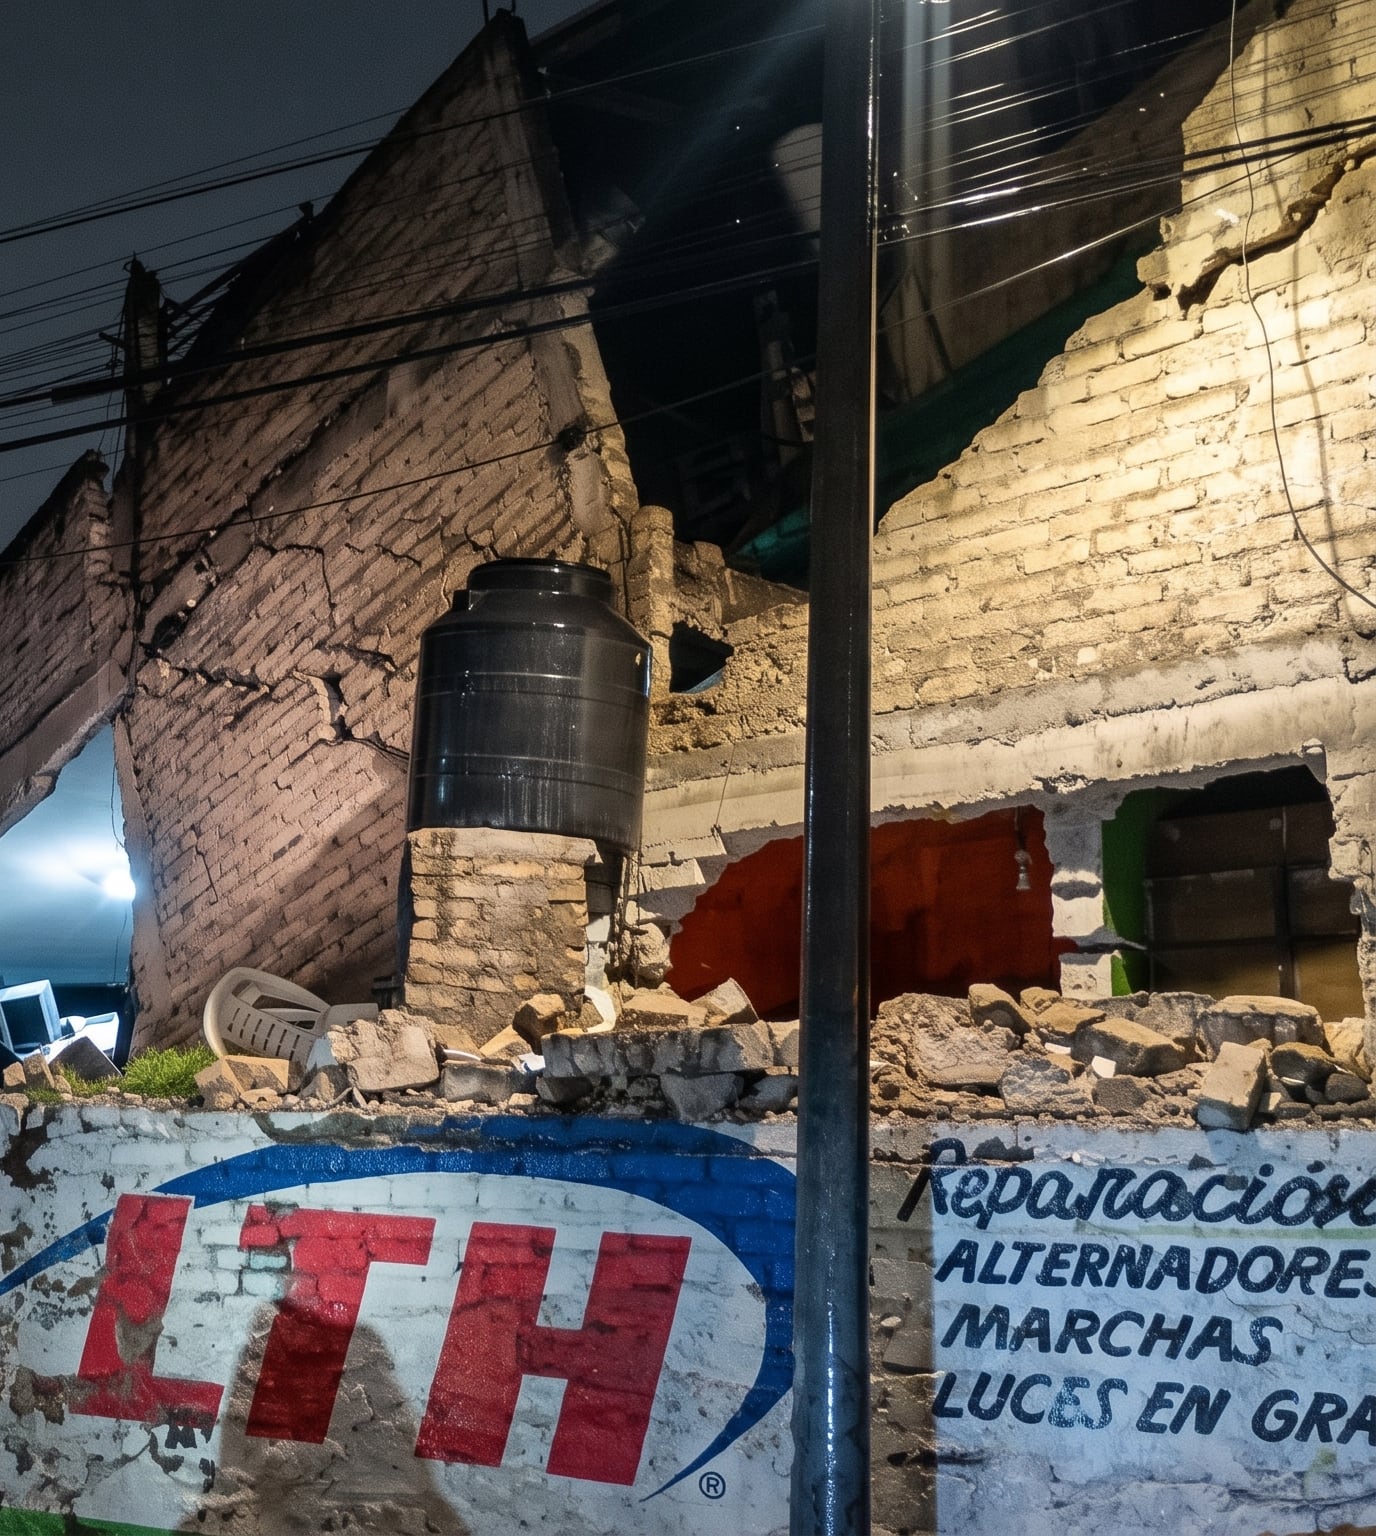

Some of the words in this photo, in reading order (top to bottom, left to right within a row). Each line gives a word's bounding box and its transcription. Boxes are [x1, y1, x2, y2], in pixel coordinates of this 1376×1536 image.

[68, 1192, 693, 1486] LTH
[940, 1303, 1284, 1367] MARCHAS
[931, 1372, 1129, 1430] LUCES
[1136, 1382, 1232, 1435] EN
[1251, 1389, 1376, 1447] GRA
